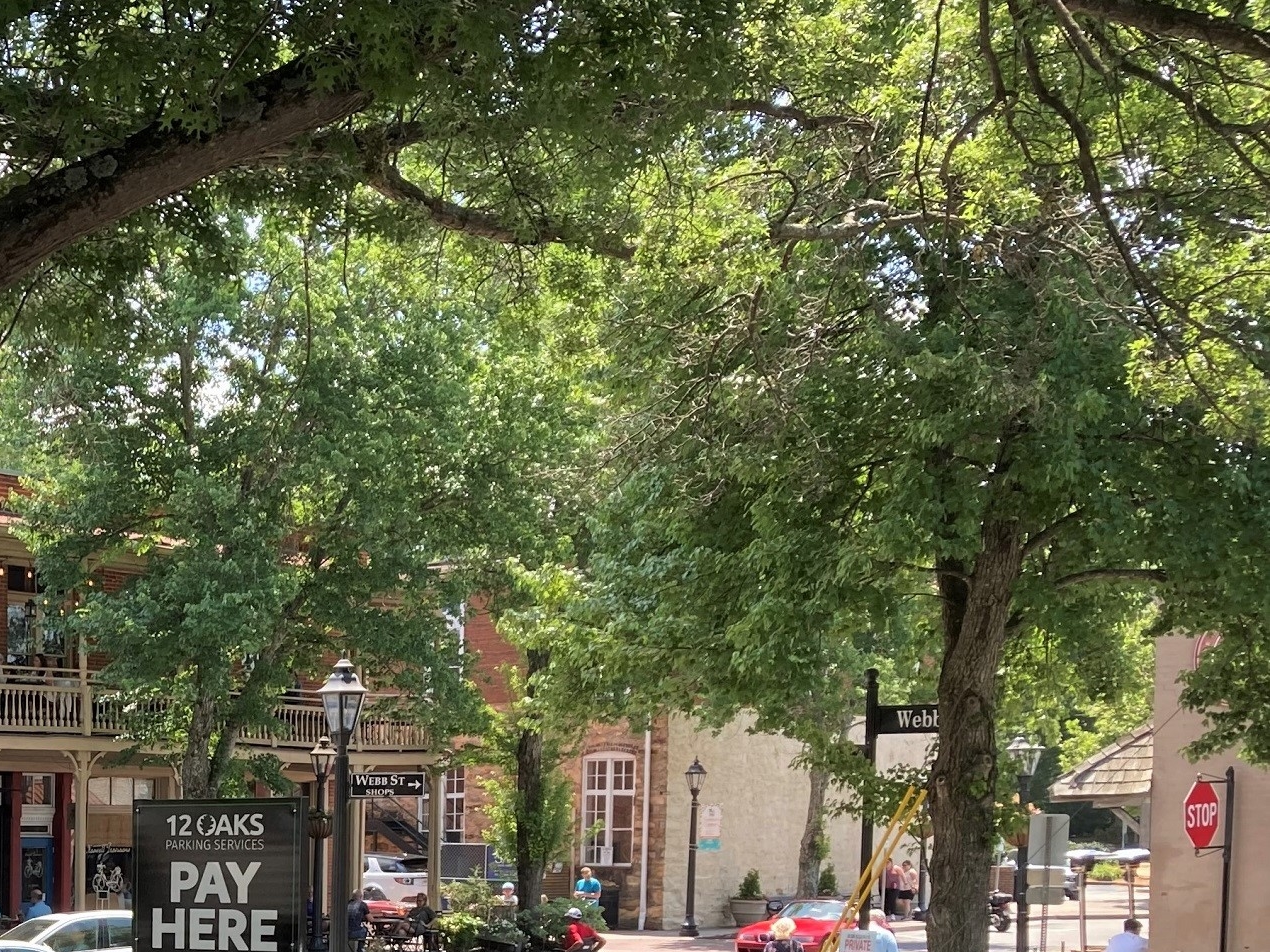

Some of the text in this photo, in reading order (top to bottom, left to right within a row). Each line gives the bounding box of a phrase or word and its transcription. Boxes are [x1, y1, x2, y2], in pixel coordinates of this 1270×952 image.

[365, 788, 395, 796] SHOPS
[166, 813, 265, 836] 12 OAKS
[1187, 802, 1217, 828] STOP
[165, 839, 265, 851] PARKING SERVICES
[170, 861, 262, 904] PAY
[152, 907, 278, 952] HERE
[844, 939, 871, 951] PRIVATE
